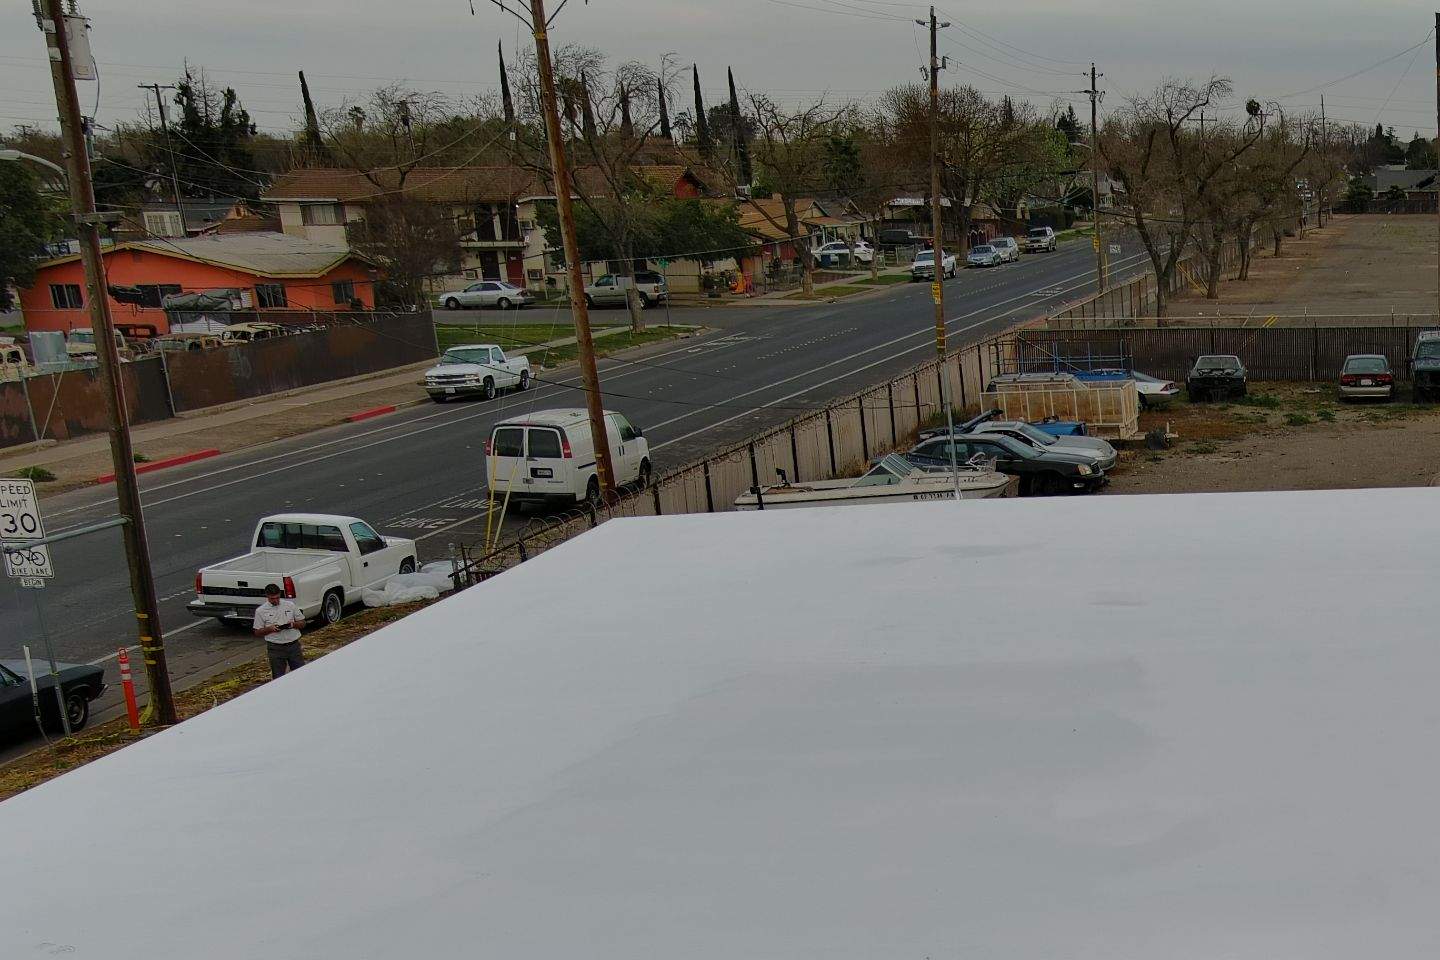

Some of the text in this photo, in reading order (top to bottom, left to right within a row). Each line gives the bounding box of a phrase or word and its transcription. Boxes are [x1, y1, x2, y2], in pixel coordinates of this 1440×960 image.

[0, 485, 31, 495] PEED
[0, 499, 28, 508] LIMIT
[1, 513, 36, 533] 30
[31, 567, 49, 575] LANE
